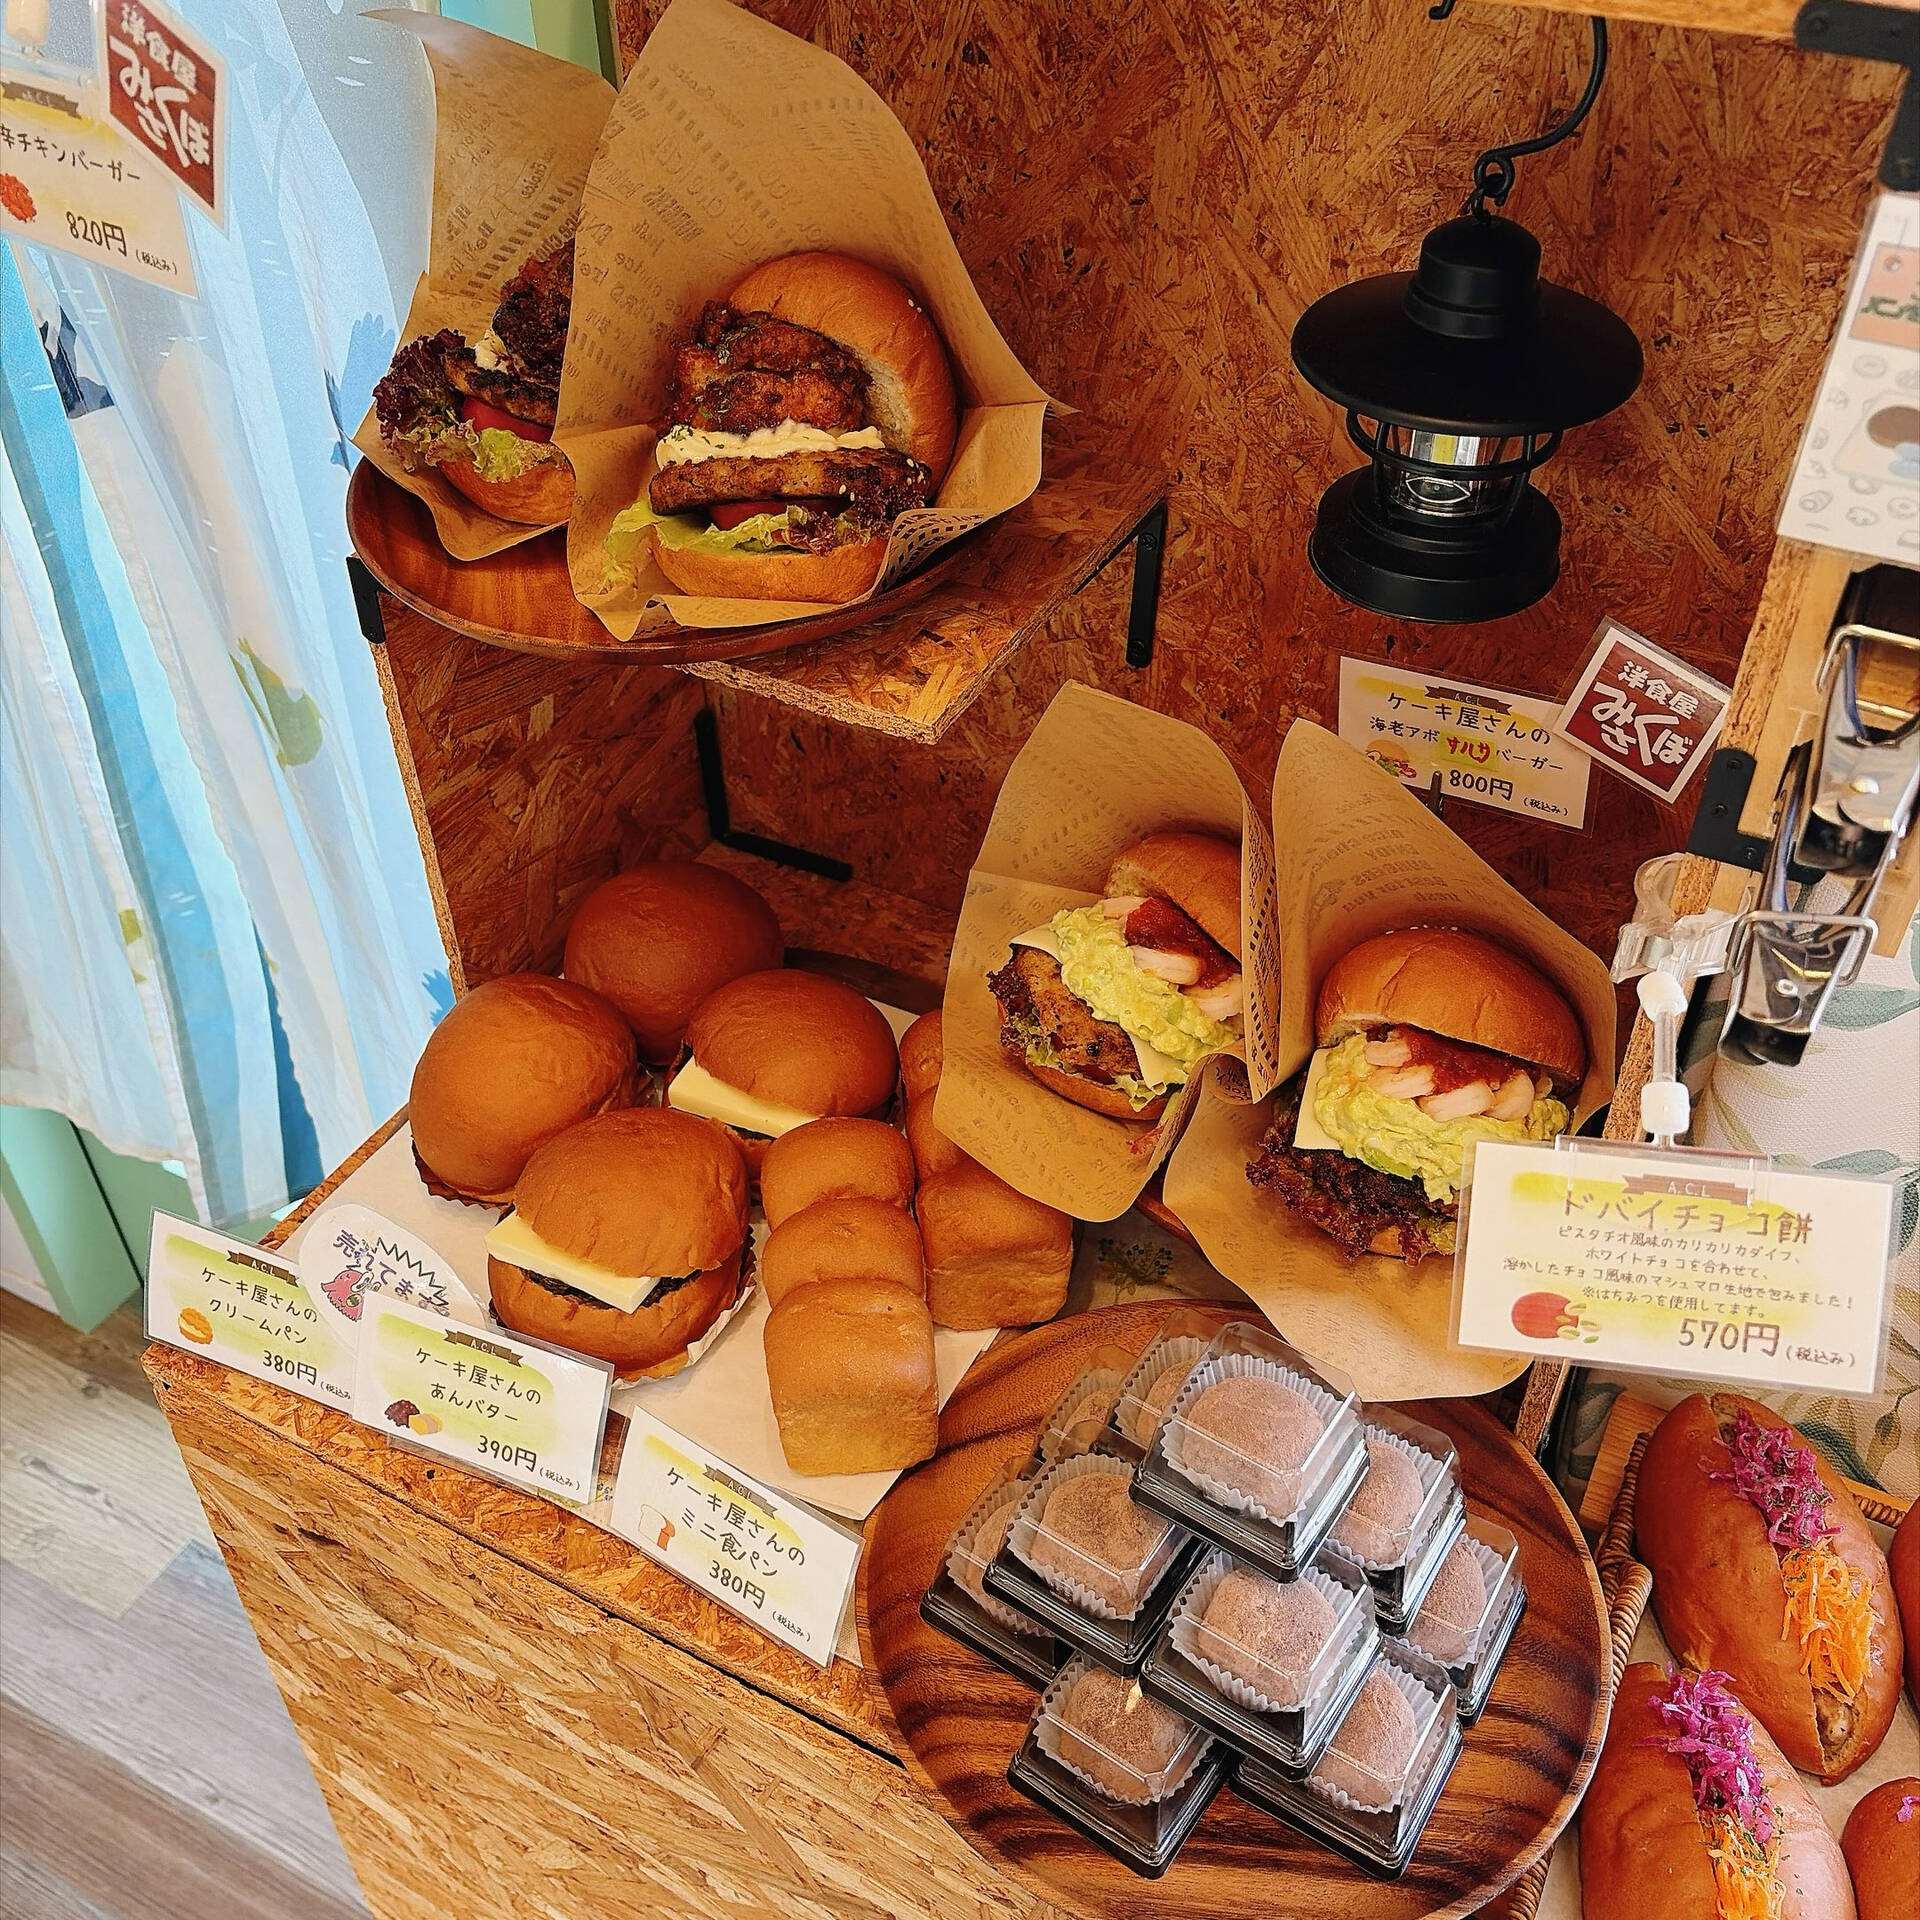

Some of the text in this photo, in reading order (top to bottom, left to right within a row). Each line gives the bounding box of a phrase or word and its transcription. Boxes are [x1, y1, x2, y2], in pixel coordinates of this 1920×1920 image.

[121, 3, 197, 94] 洋食屋
[66, 211, 177, 275] 820円 (税込み)
[1617, 660, 1699, 720] 洋食屋
[1388, 692, 1550, 745] ケーキ屋さんの
[1449, 769, 1568, 816] 800円 (税込み)
[1564, 1189, 1813, 1244] ドバイチョコ餅
[1559, 1225, 1800, 1264] ピスタチオ風味のカリカリカダイフ、
[1586, 1249, 1767, 1280] ホワイトチョコを合わせて、
[202, 1267, 317, 1323] ケーキ屋さんの
[209, 1298, 307, 1344] クリームパン
[263, 1350, 317, 1386] 380円
[1678, 1318, 1855, 1367] 570円 (税込み)
[416, 1348, 541, 1405] ケーキ屋さんの
[431, 1382, 518, 1421] あんバター
[477, 1435, 580, 1491] 390円 (税込み)
[667, 1467, 805, 1566] ケーキ屋さんの
[681, 1507, 777, 1577] ミニ食パン
[709, 1560, 811, 1642] 380円 (税込み)
